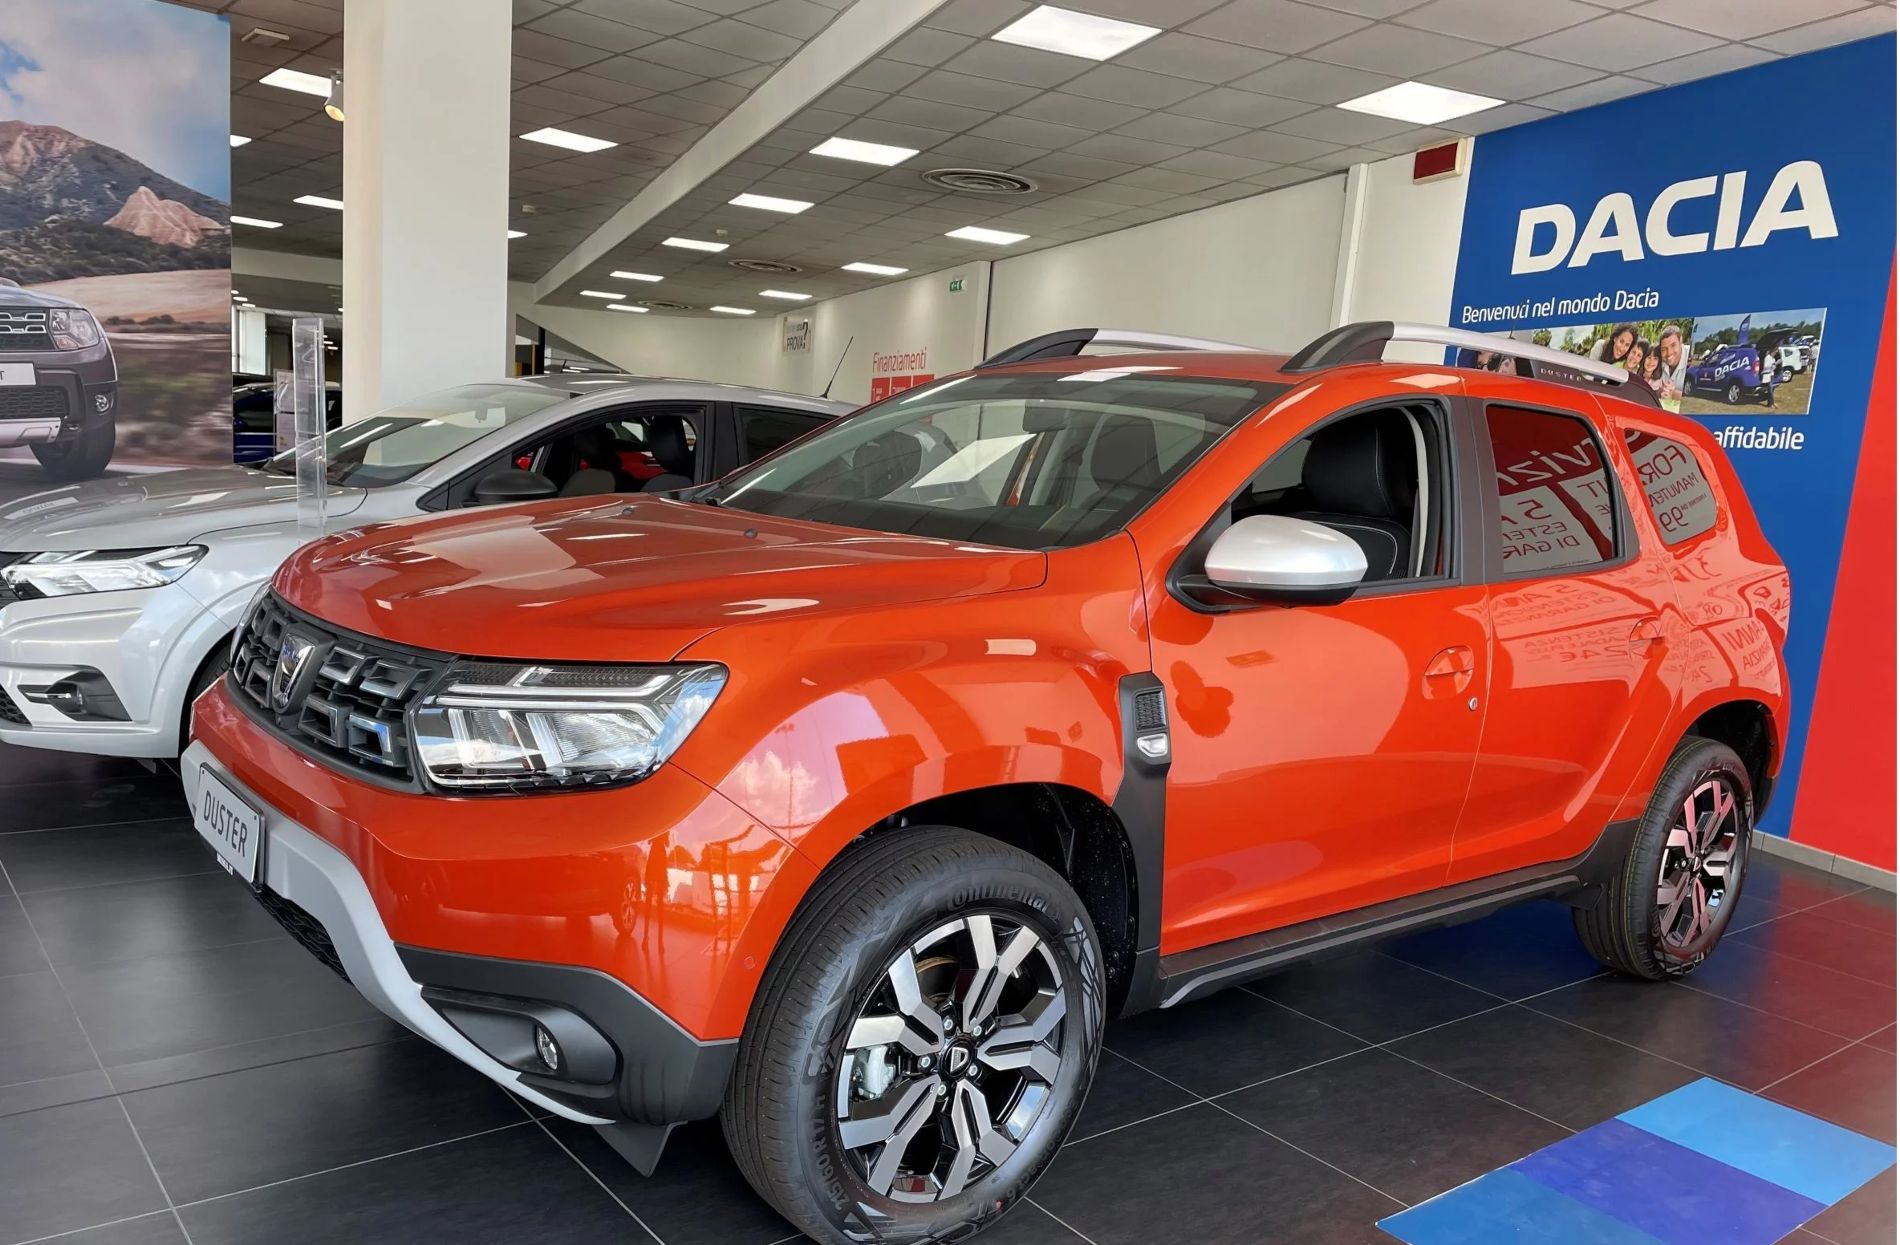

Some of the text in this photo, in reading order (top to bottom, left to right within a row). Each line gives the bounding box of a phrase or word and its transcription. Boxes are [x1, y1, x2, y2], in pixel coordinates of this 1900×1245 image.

[1510, 160, 1839, 275] DACIA
[1532, 297, 1555, 317] nel
[1558, 295, 1611, 316] mondo
[1614, 288, 1660, 311] Dacia
[873, 345, 928, 373] Finanziamenti
[1715, 356, 1749, 377] DACIA
[1713, 425, 1805, 451] affidabile
[203, 790, 248, 858] DUSTER
